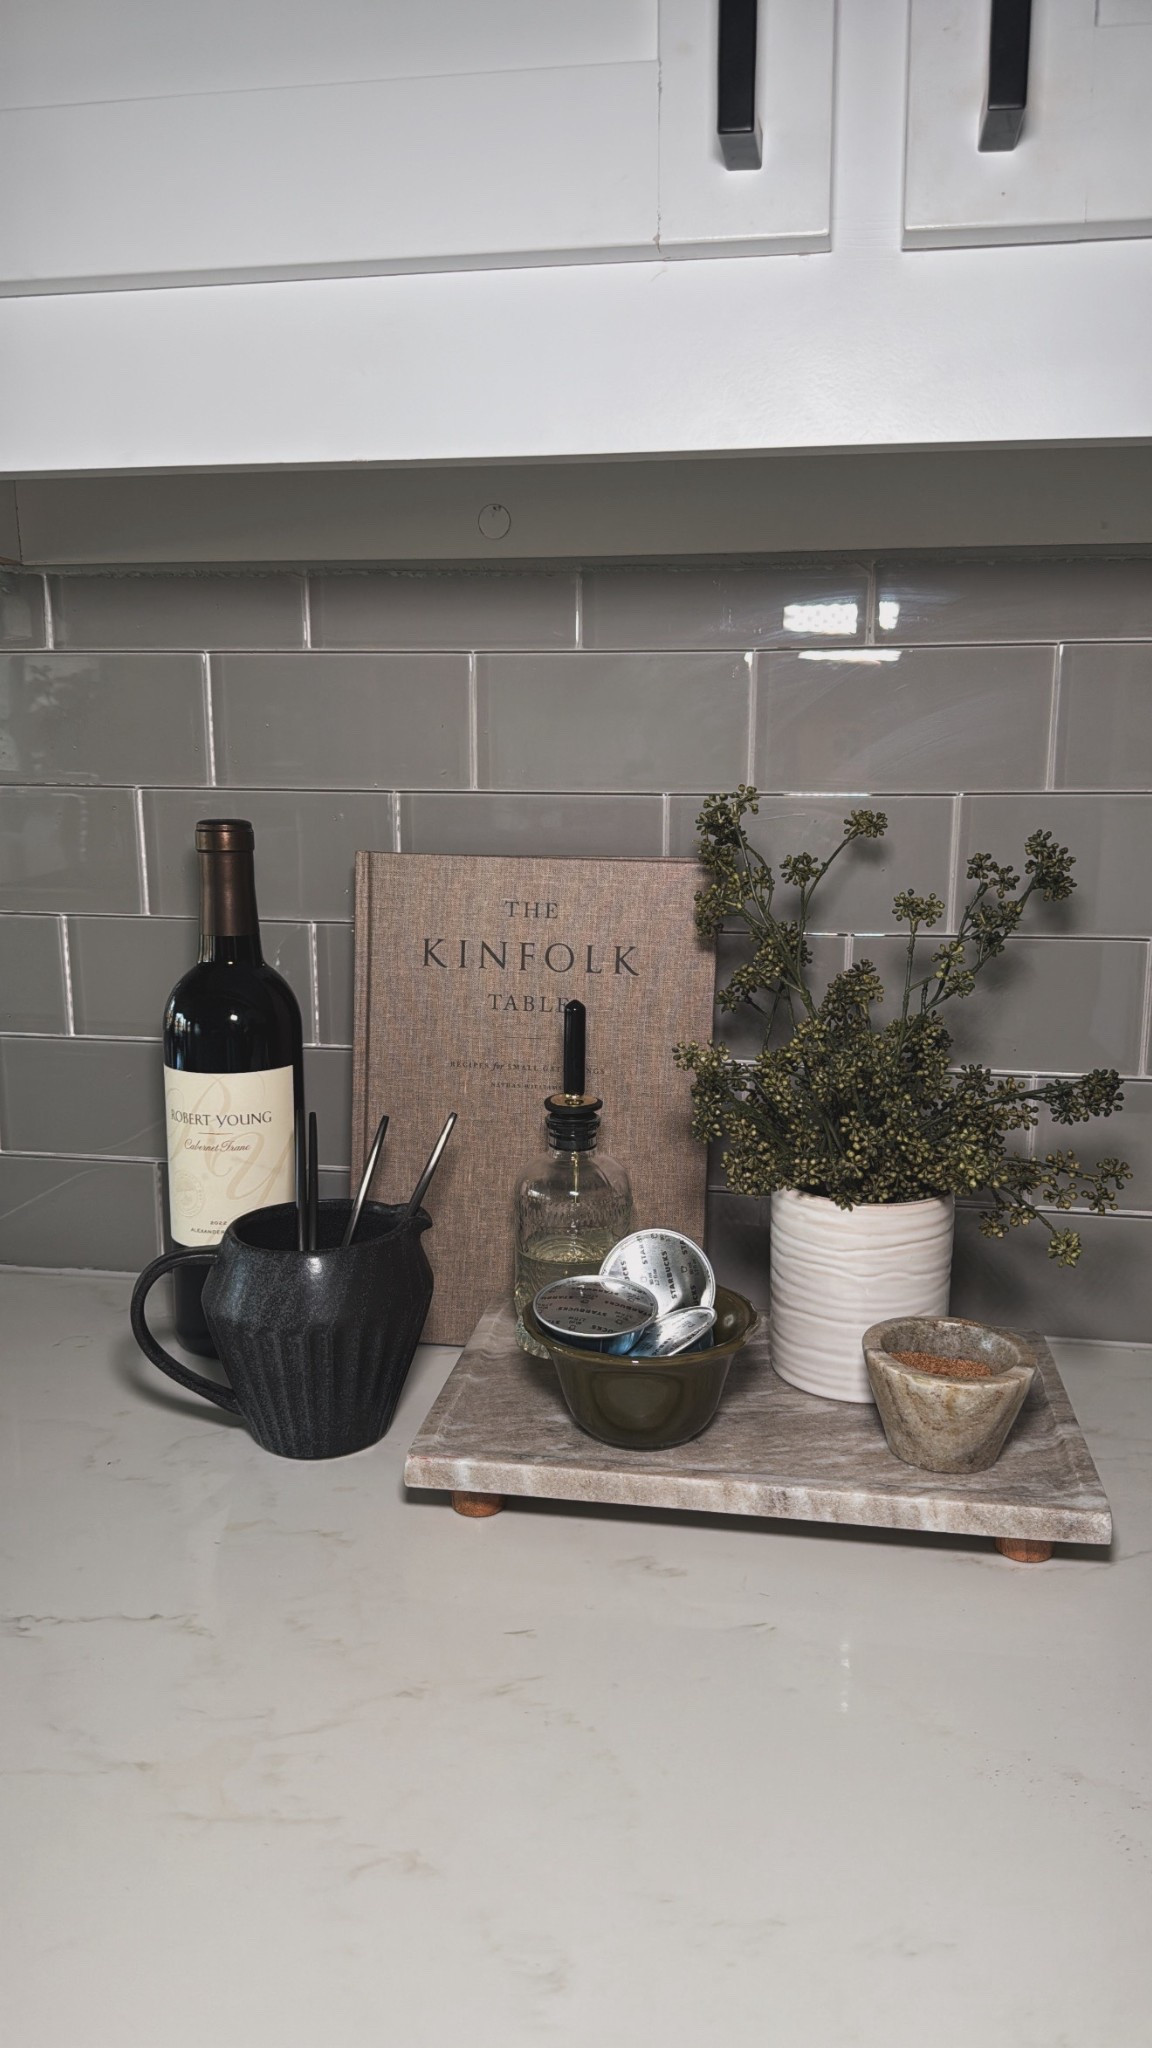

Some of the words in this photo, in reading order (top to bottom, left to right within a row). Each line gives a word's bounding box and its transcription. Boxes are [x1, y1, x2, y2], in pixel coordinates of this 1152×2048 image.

[504, 900, 559, 919] THE
[422, 937, 640, 977] KINFOLK
[487, 993, 569, 1013] TABLE
[450, 1061, 489, 1070] RECIPES
[491, 1061, 503, 1072] for
[507, 1063, 538, 1072] SMALL
[542, 1065, 605, 1075] GATNGS
[170, 1109, 211, 1126] ROBERT
[215, 1110, 273, 1128] YOUNG
[184, 1138, 219, 1152] Cabernet
[218, 1140, 250, 1153] Franc
[660, 1249, 678, 1300] STARBUCKS
[556, 1306, 608, 1318] STARBUCKS
